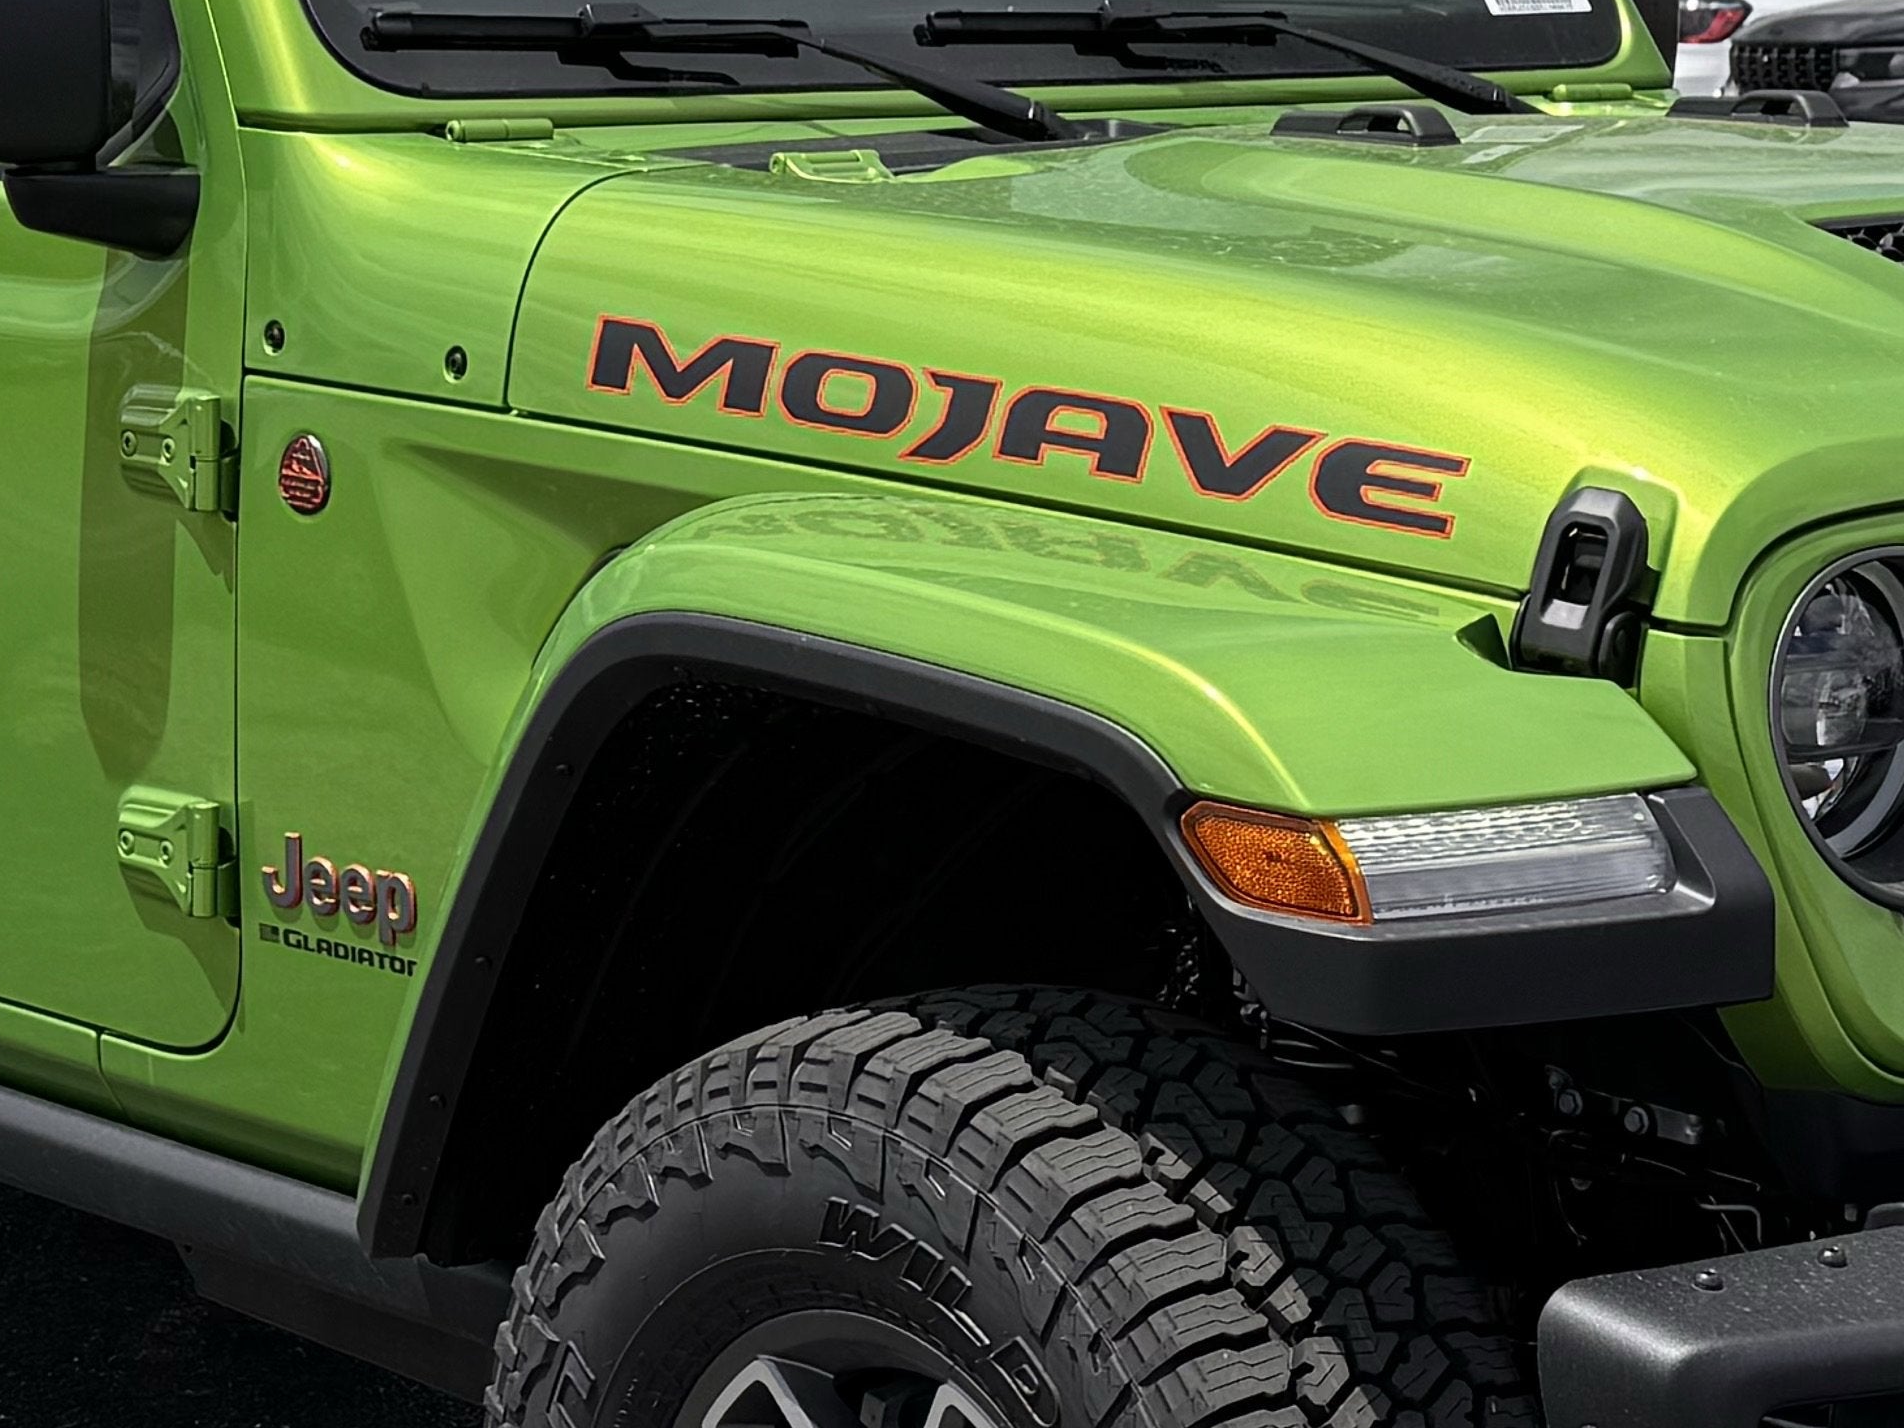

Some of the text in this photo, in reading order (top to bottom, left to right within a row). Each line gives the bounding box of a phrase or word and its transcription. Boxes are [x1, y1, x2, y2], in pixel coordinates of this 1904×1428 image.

[586, 312, 1472, 539] MOJAVE
[261, 831, 418, 947] Jeep
[283, 927, 418, 977] GLADIATOR
